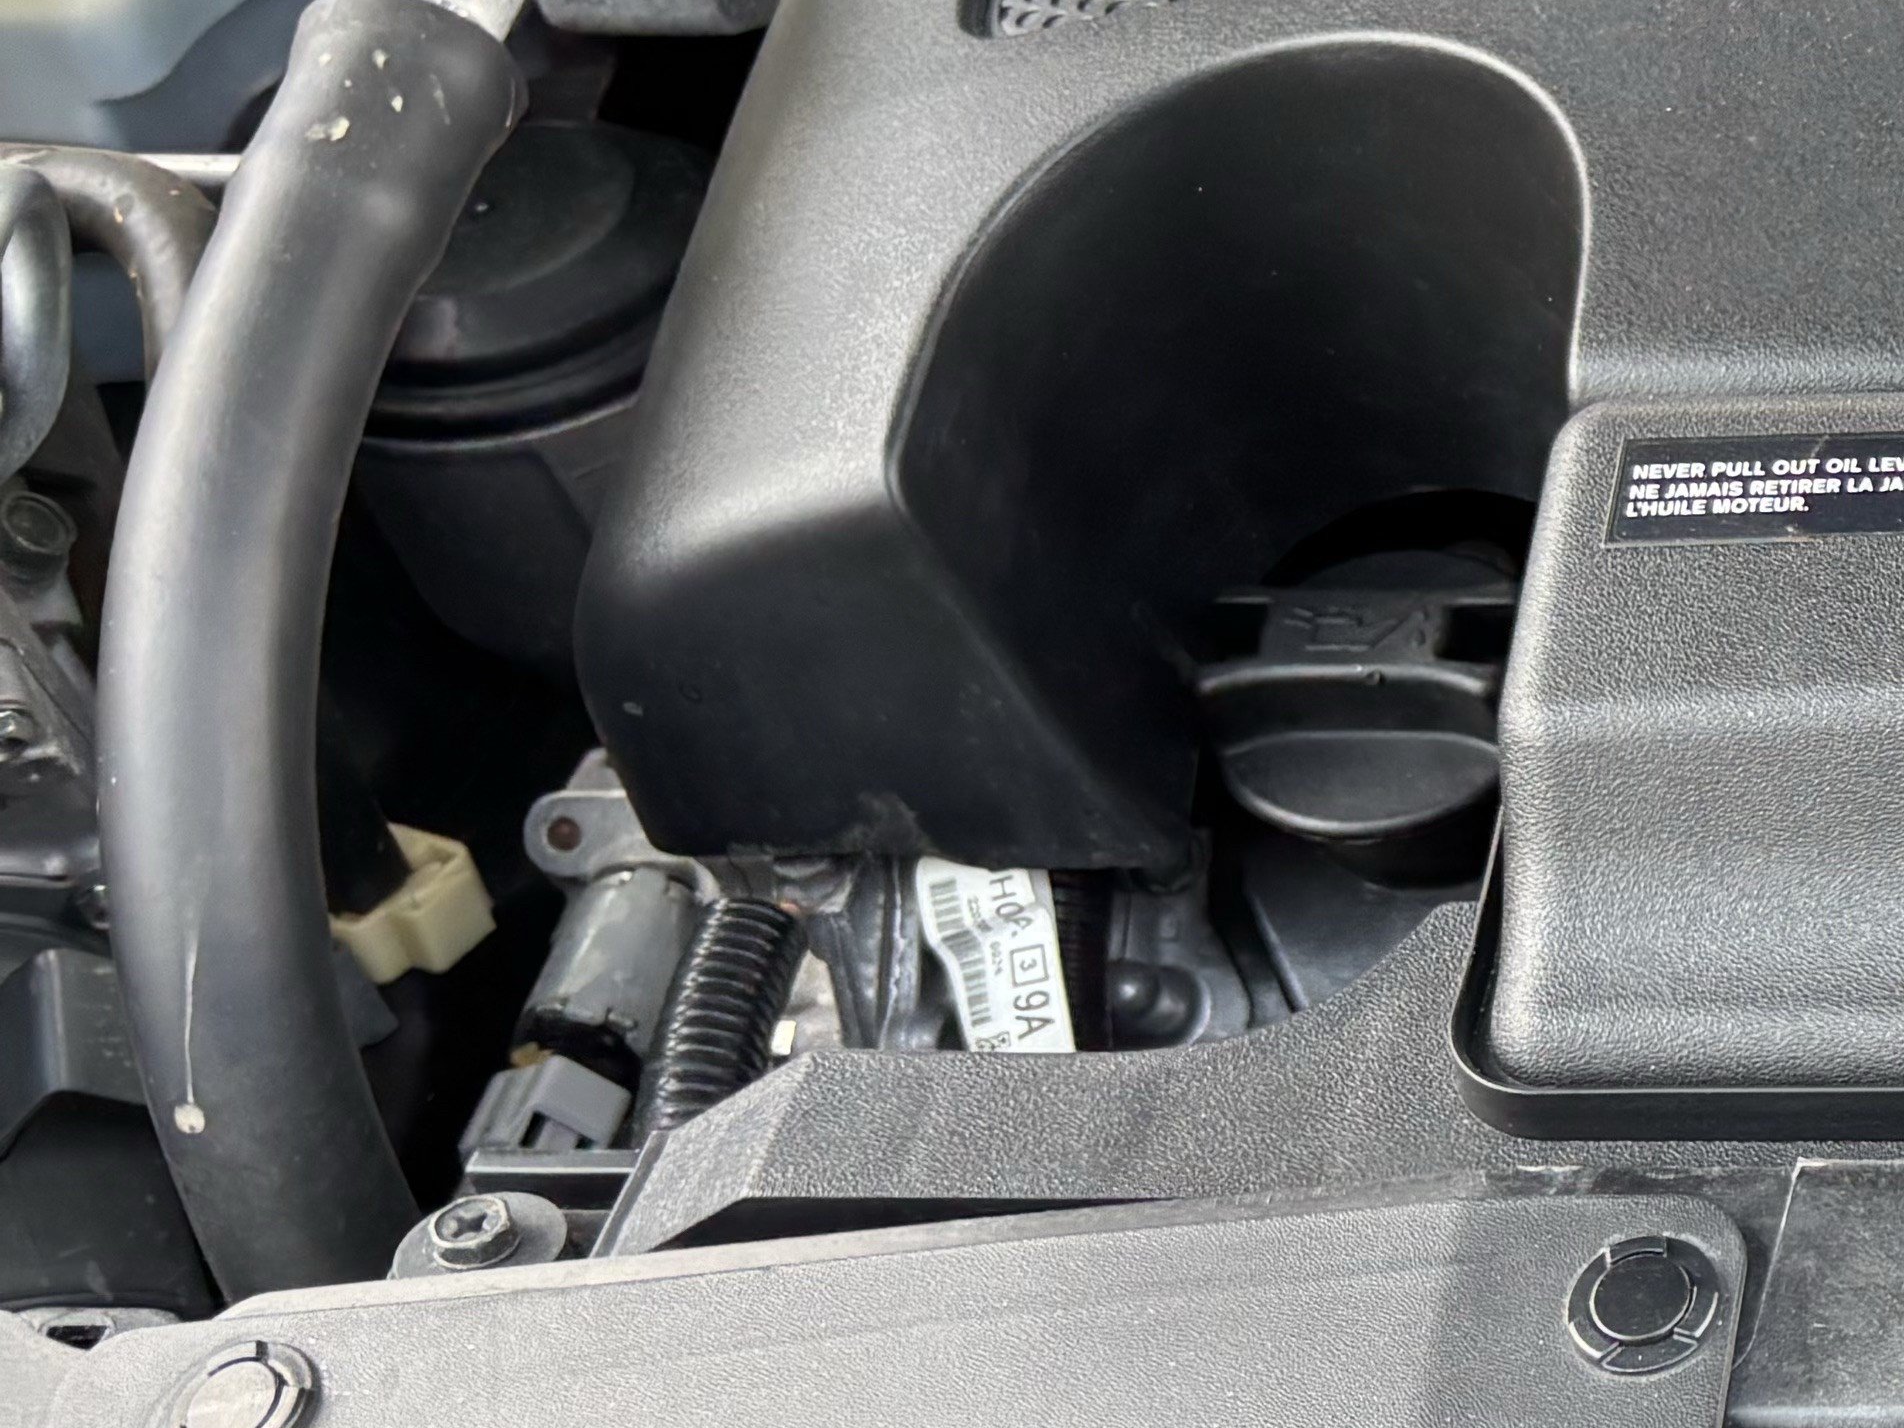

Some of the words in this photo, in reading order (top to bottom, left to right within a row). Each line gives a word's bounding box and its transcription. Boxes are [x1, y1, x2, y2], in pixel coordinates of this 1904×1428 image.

[1632, 462, 1705, 480] NEVER
[1711, 460, 1765, 477] PULL
[1772, 458, 1820, 476] OUT
[1825, 457, 1862, 474] OIL
[1629, 483, 1660, 500] NE
[1664, 481, 1743, 499] JAMAIS
[1750, 478, 1841, 496] RETIRER
[1847, 477, 1873, 493] LA
[1626, 500, 1706, 517] L'HUILE
[1712, 496, 1809, 515] MOTEUR.
[1013, 990, 1056, 1041] 9A
